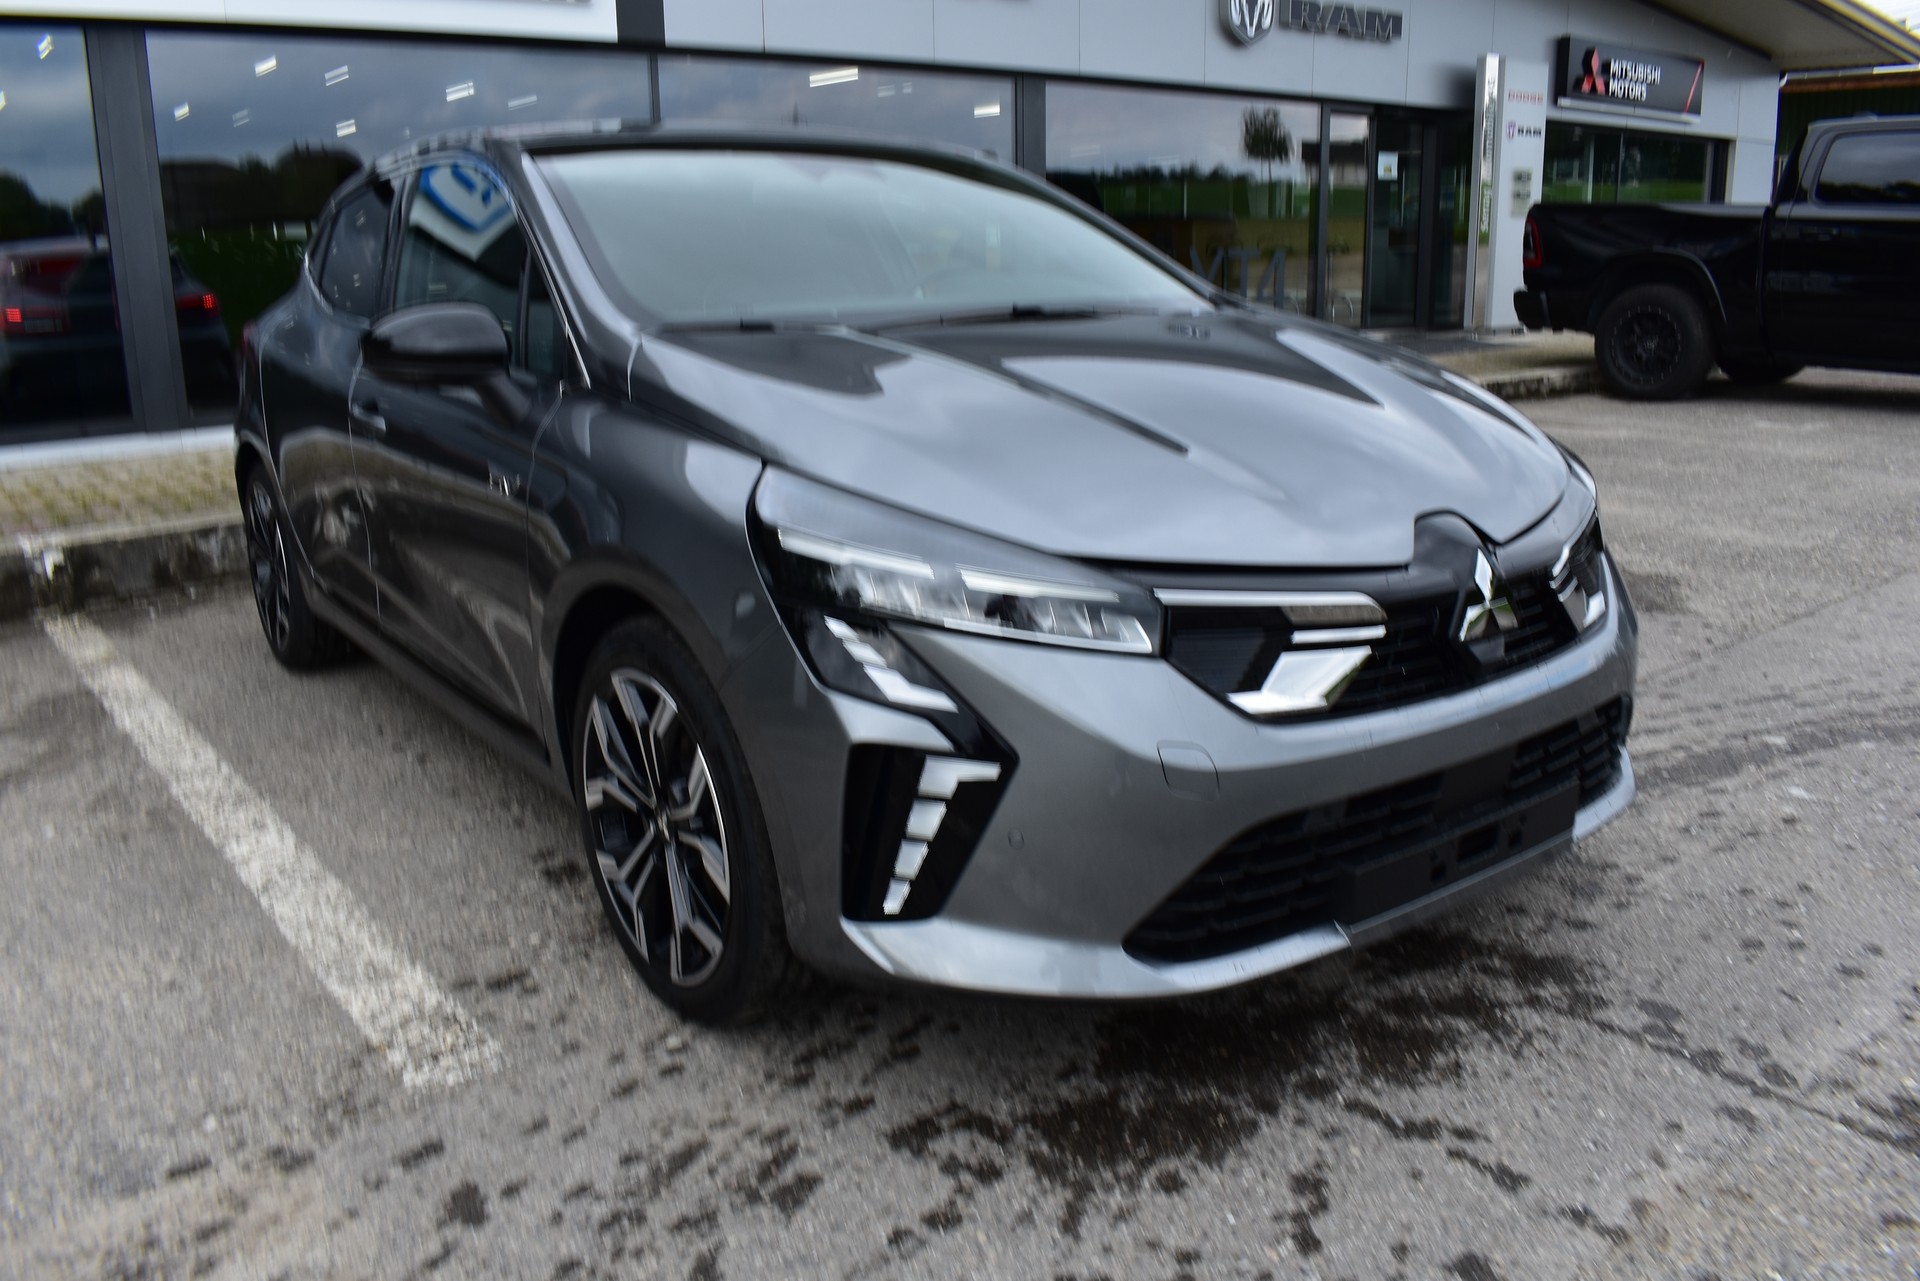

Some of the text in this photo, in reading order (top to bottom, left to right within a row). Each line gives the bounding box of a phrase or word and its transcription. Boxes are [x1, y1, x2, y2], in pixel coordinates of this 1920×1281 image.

[1289, 0, 1403, 39] RAM
[1610, 58, 1661, 85] MITSUBISHI
[1609, 79, 1647, 101] MOTORS
